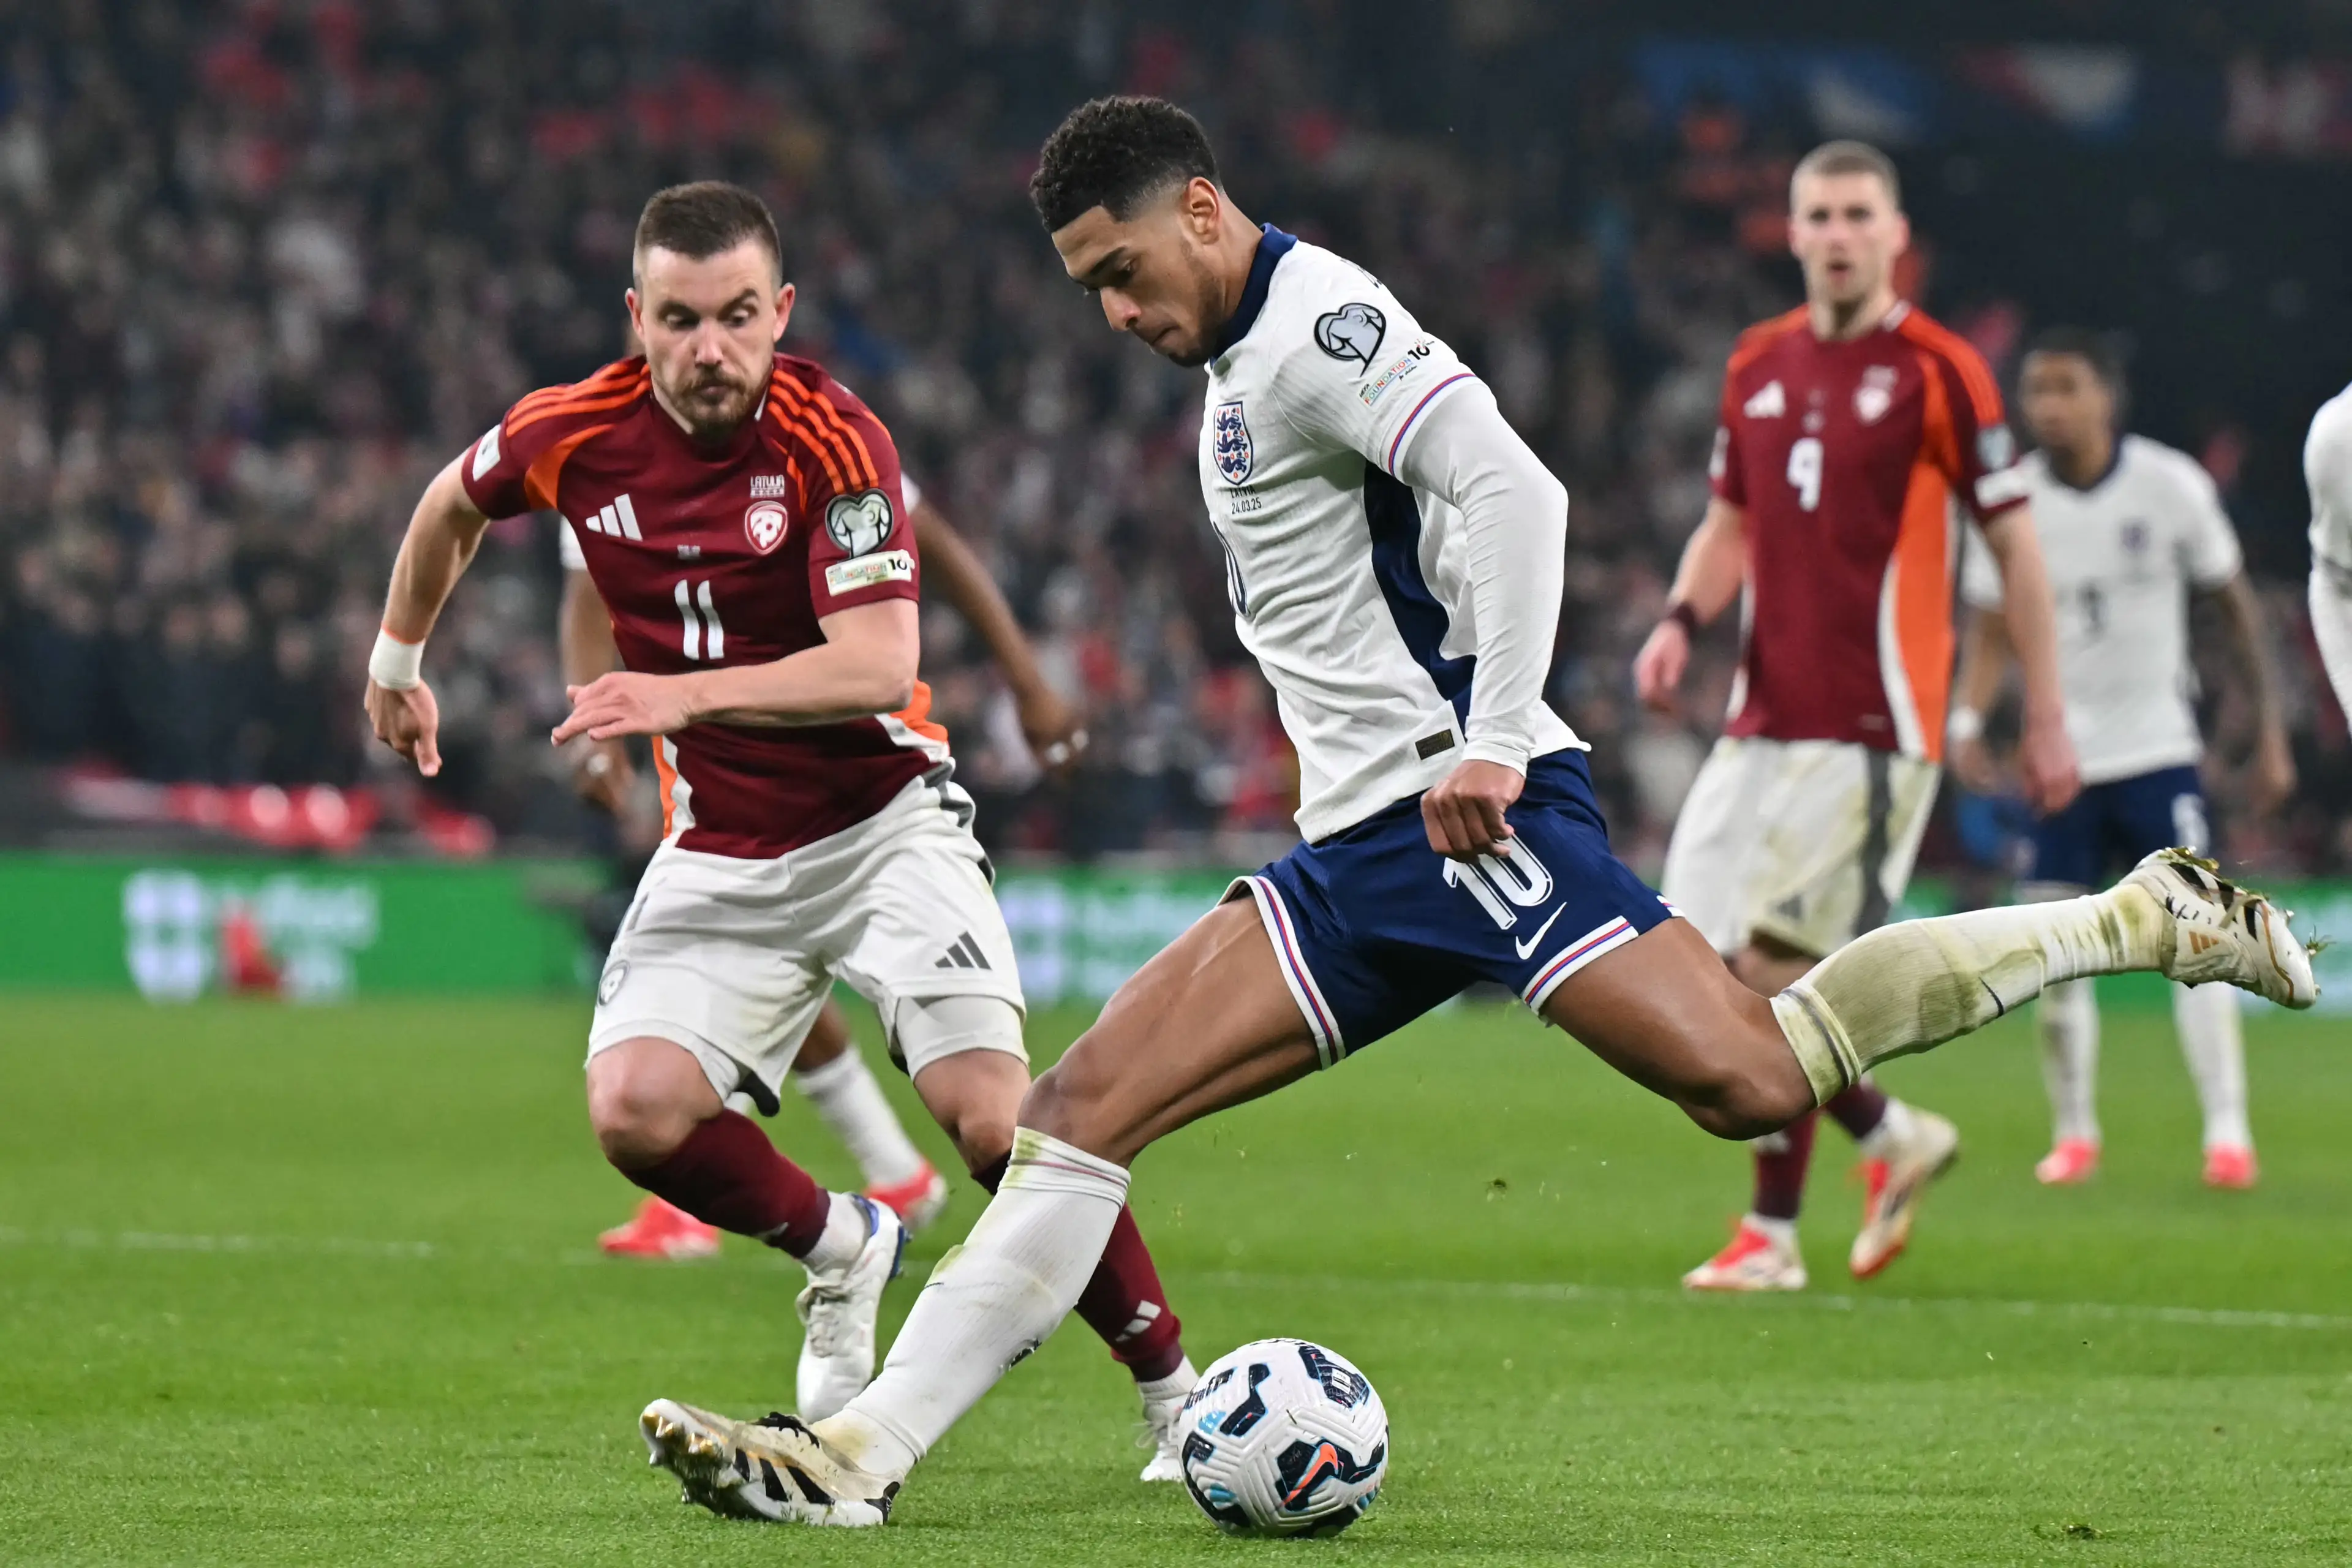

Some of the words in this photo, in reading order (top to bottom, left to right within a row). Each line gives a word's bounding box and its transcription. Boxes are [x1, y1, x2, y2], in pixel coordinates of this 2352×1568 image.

[1408, 344, 1430, 360] 10
[1364, 358, 1412, 405] FOUNDATION
[1787, 437, 1823, 512] 9
[1231, 496, 1262, 514] 24.03.25
[888, 557, 908, 571] 10
[674, 579, 725, 660] 11
[1442, 833, 1553, 930] 10
